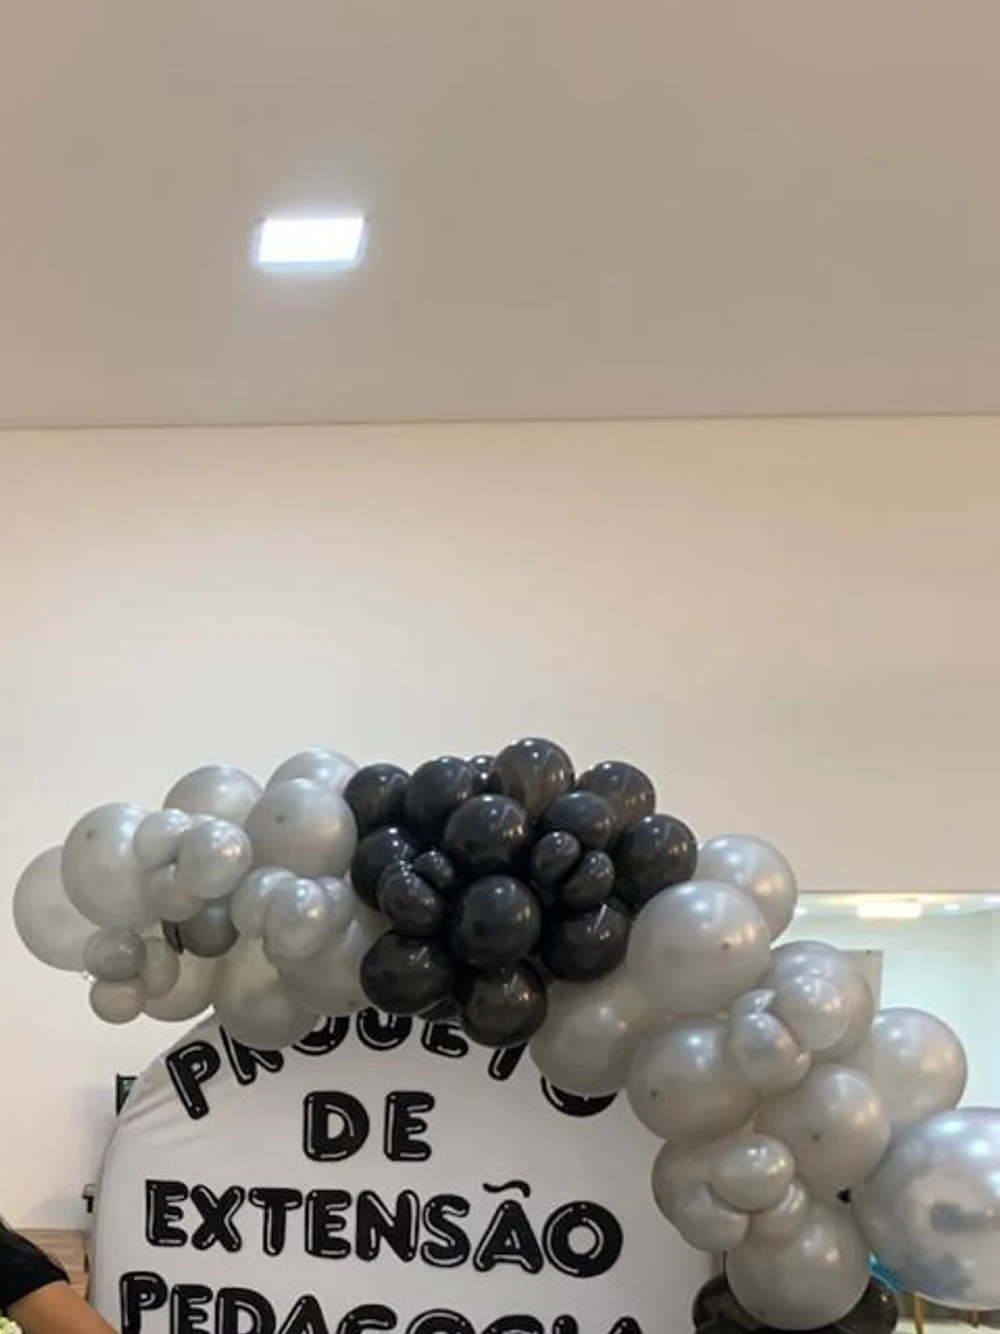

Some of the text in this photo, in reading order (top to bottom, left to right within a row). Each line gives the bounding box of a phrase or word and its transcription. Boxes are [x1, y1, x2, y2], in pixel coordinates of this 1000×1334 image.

[165, 1005, 618, 1120] PRJE
[303, 1090, 435, 1162] DE
[145, 1179, 624, 1278] EXTENSÃO
